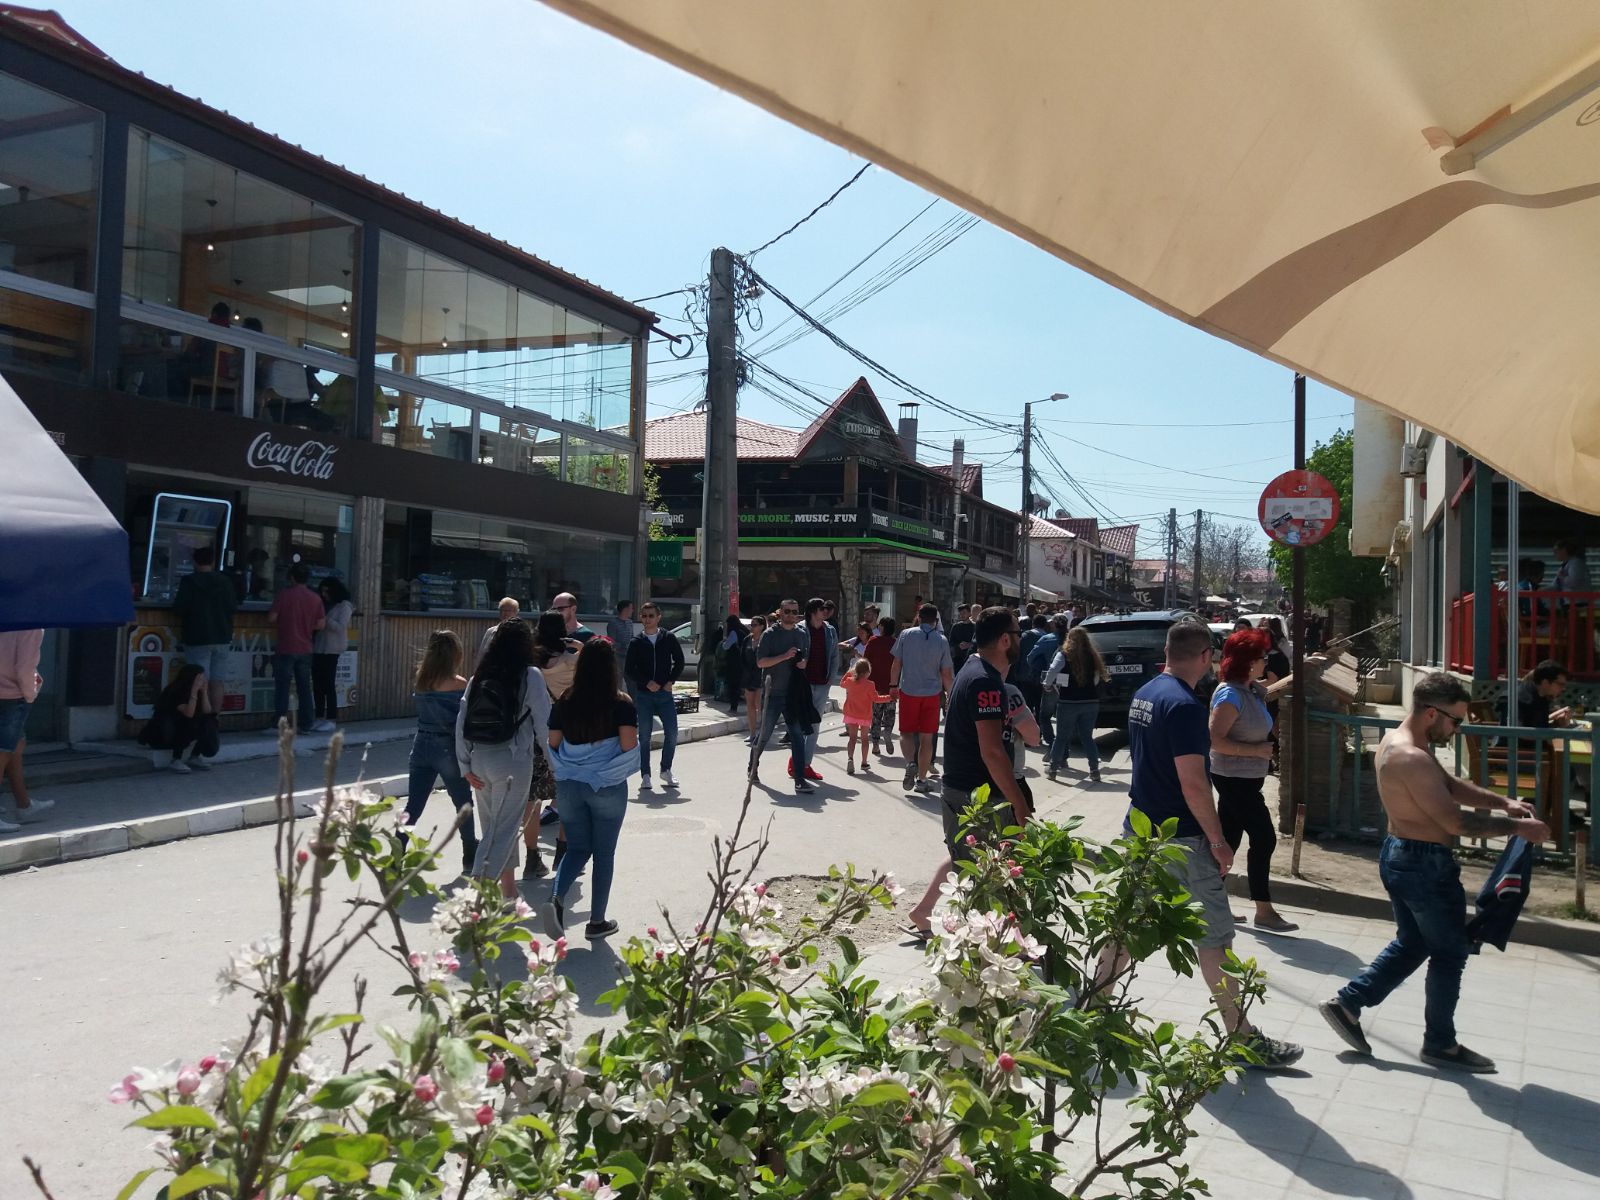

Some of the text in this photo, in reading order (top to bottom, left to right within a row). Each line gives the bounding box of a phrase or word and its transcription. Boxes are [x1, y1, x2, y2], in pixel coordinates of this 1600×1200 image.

[247, 432, 339, 479] Coca-Cola
[737, 514, 756, 523] OR
[834, 514, 857, 523] FUN
[977, 690, 1001, 708] SD
